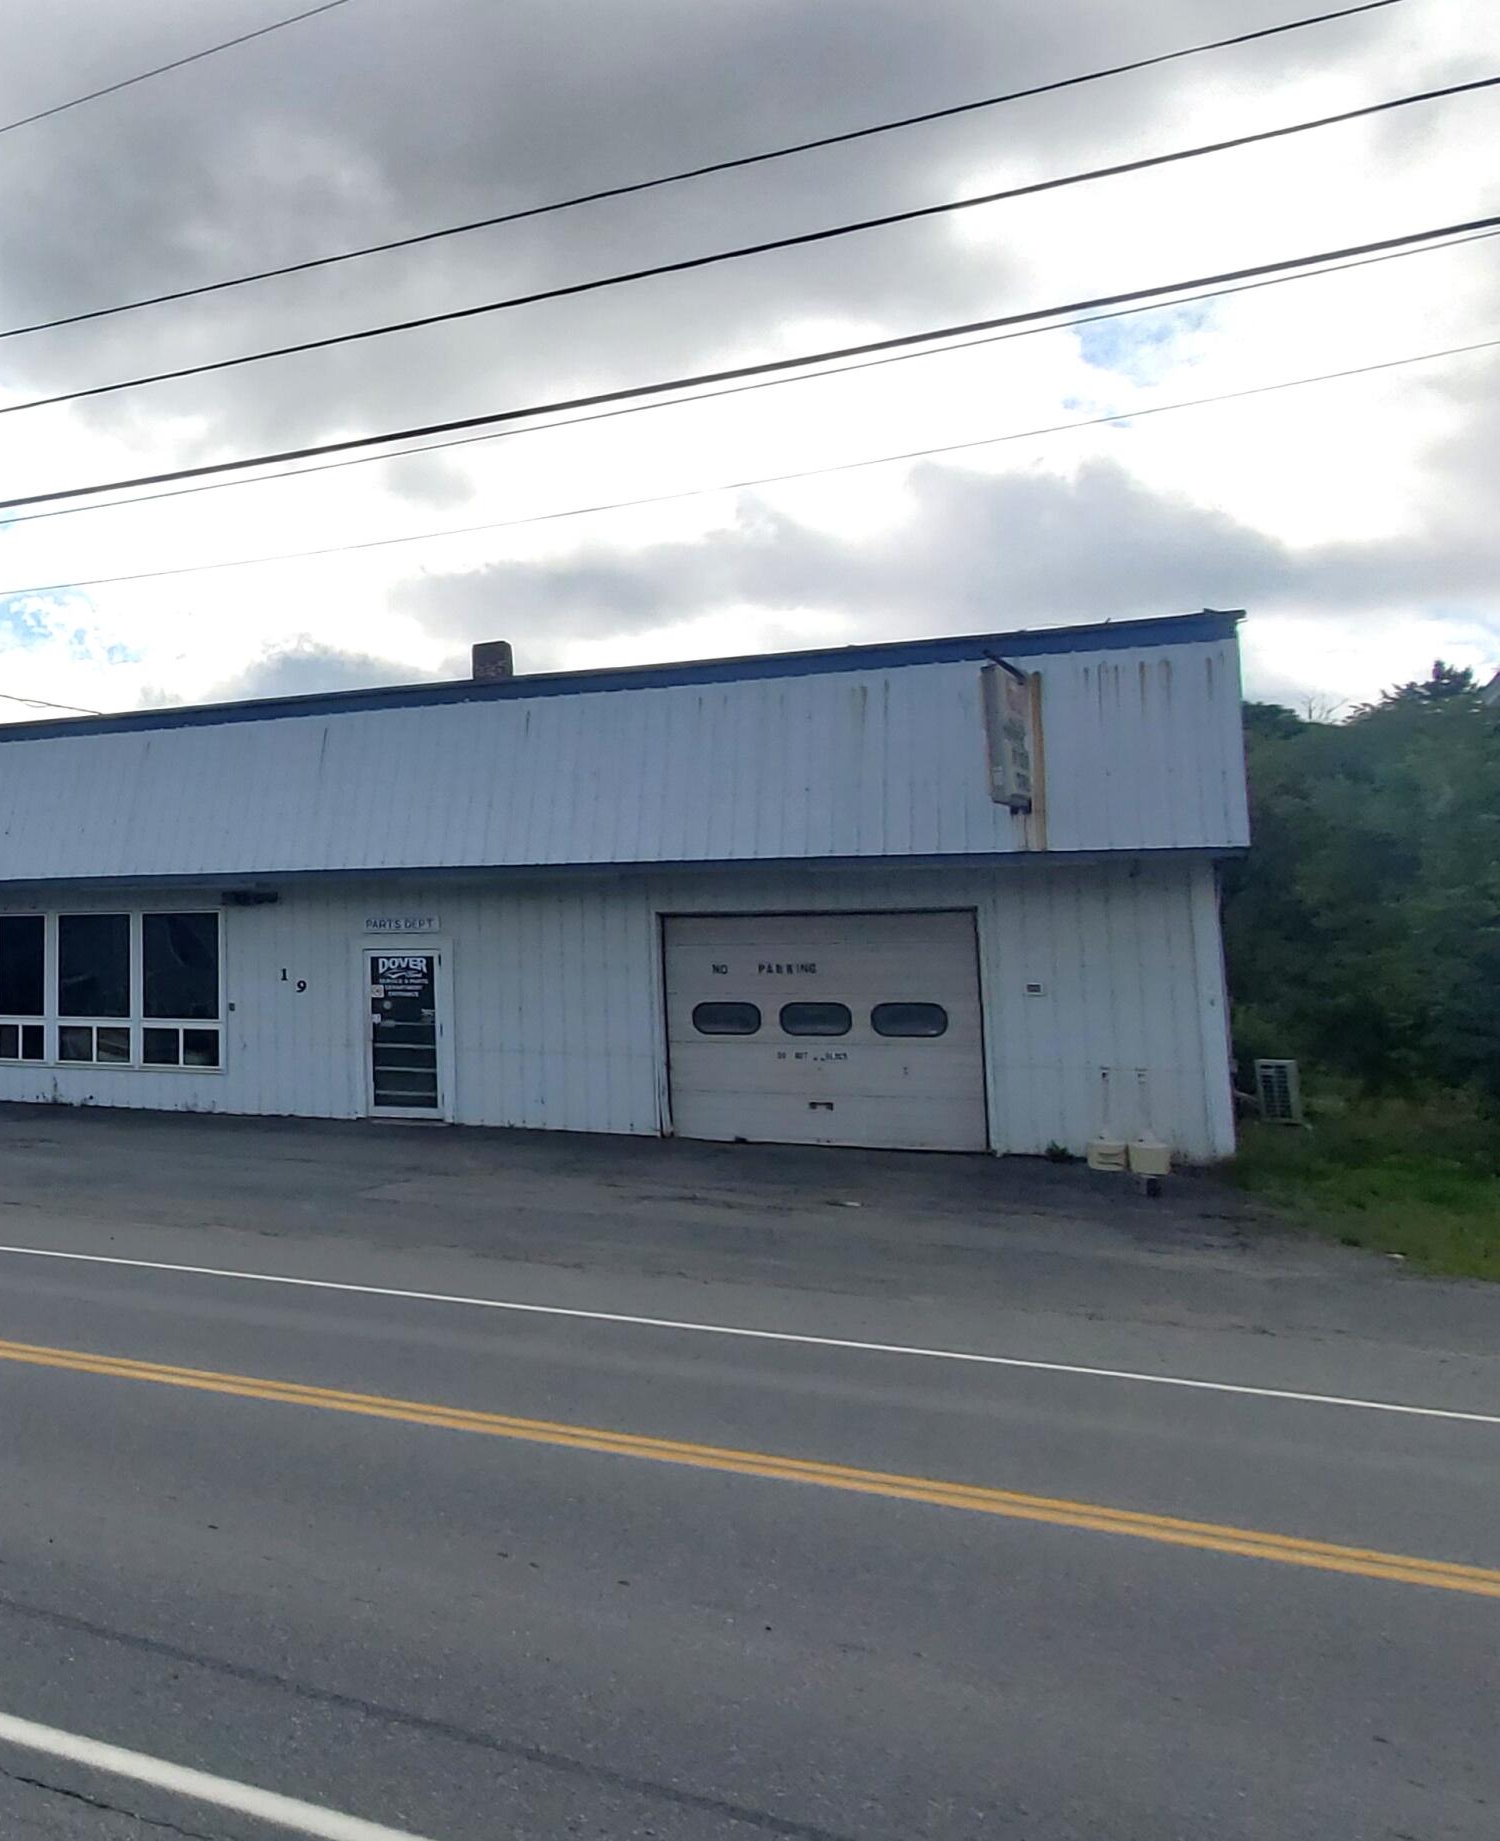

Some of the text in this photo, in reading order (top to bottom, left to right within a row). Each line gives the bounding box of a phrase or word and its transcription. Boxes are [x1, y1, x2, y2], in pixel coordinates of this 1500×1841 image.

[366, 918, 433, 929] PARTS DEPT
[378, 957, 428, 974] DOVER
[712, 963, 817, 974] NO PARKING
